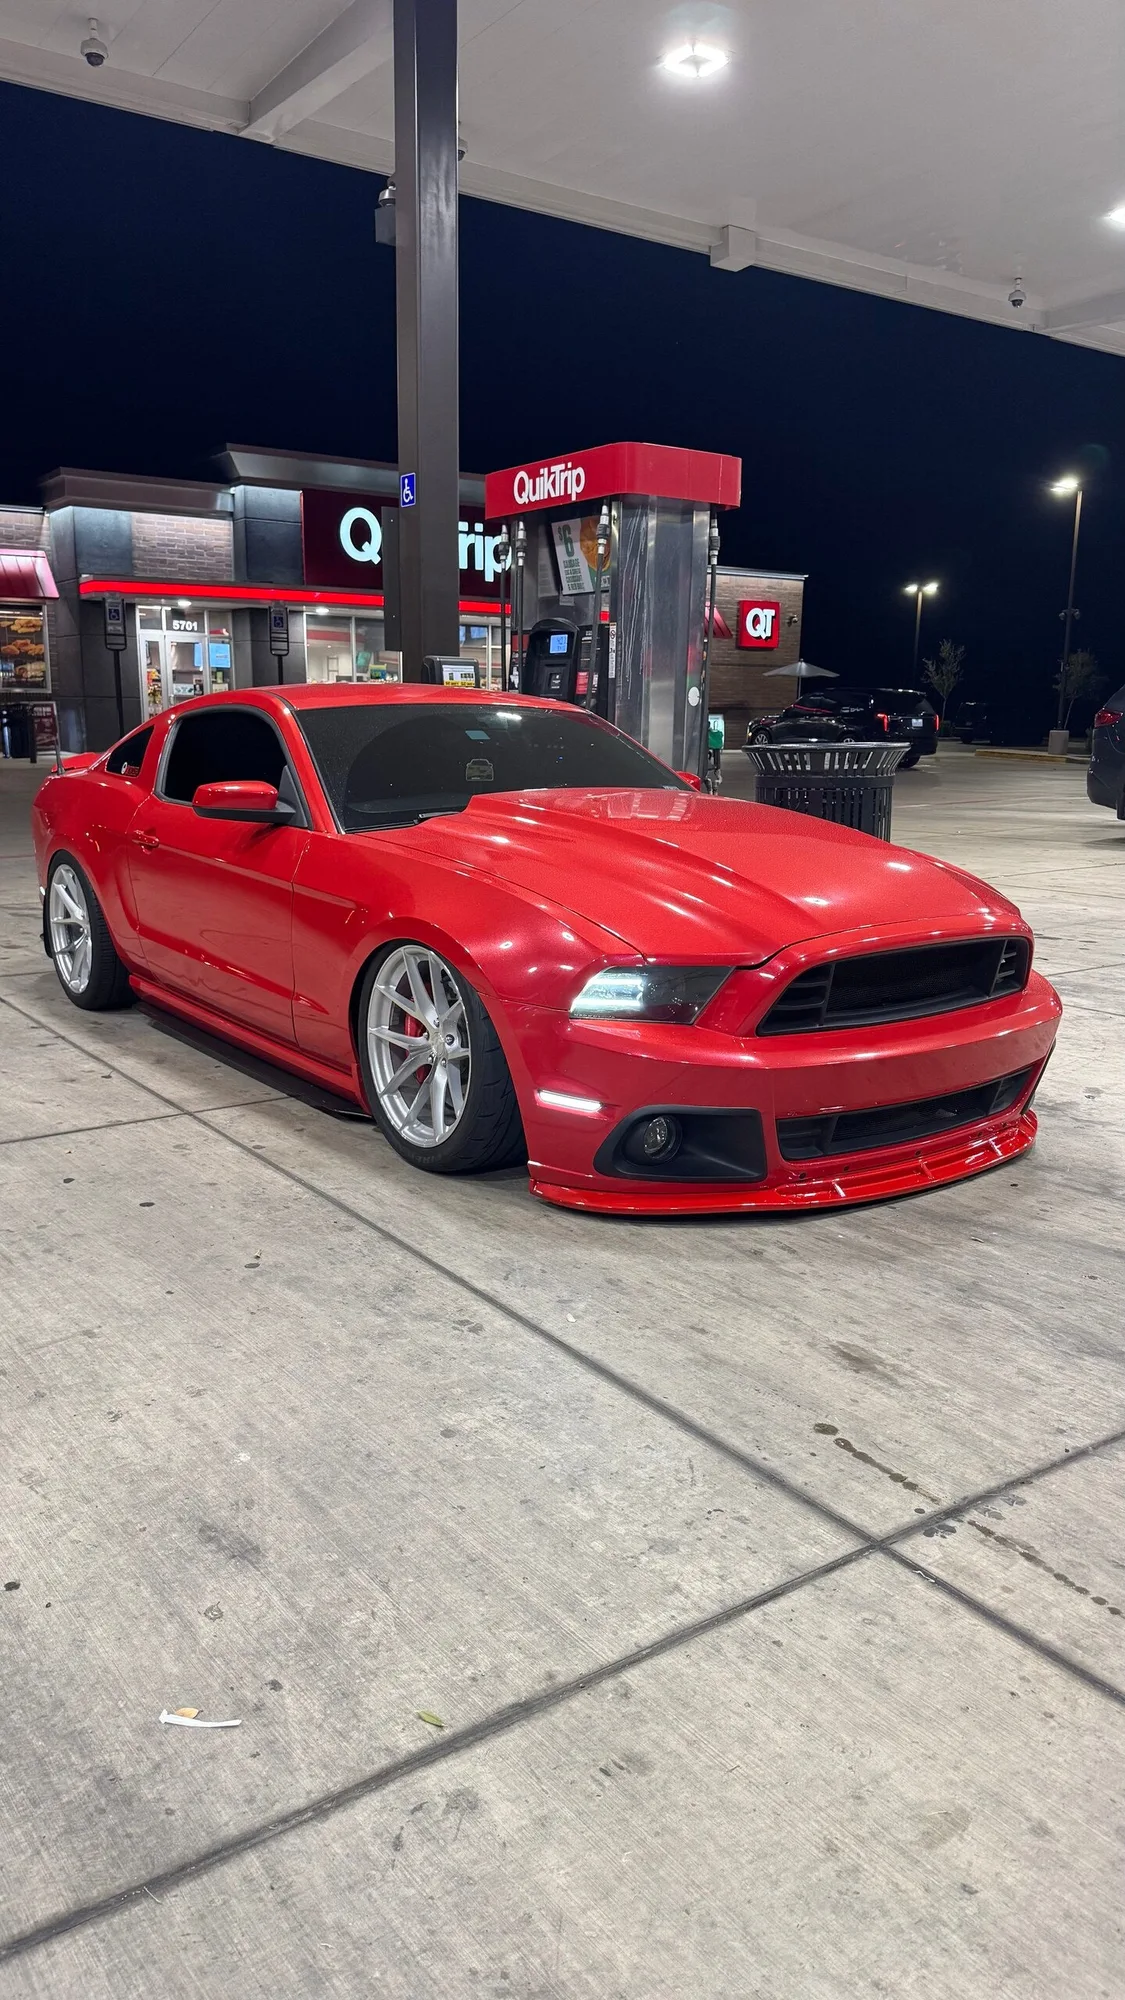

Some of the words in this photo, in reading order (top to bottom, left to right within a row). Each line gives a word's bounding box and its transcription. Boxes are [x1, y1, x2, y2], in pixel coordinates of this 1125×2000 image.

[513, 461, 586, 505] QuikTrip
[172, 620, 198, 631] 5701
[745, 607, 776, 640] QT
